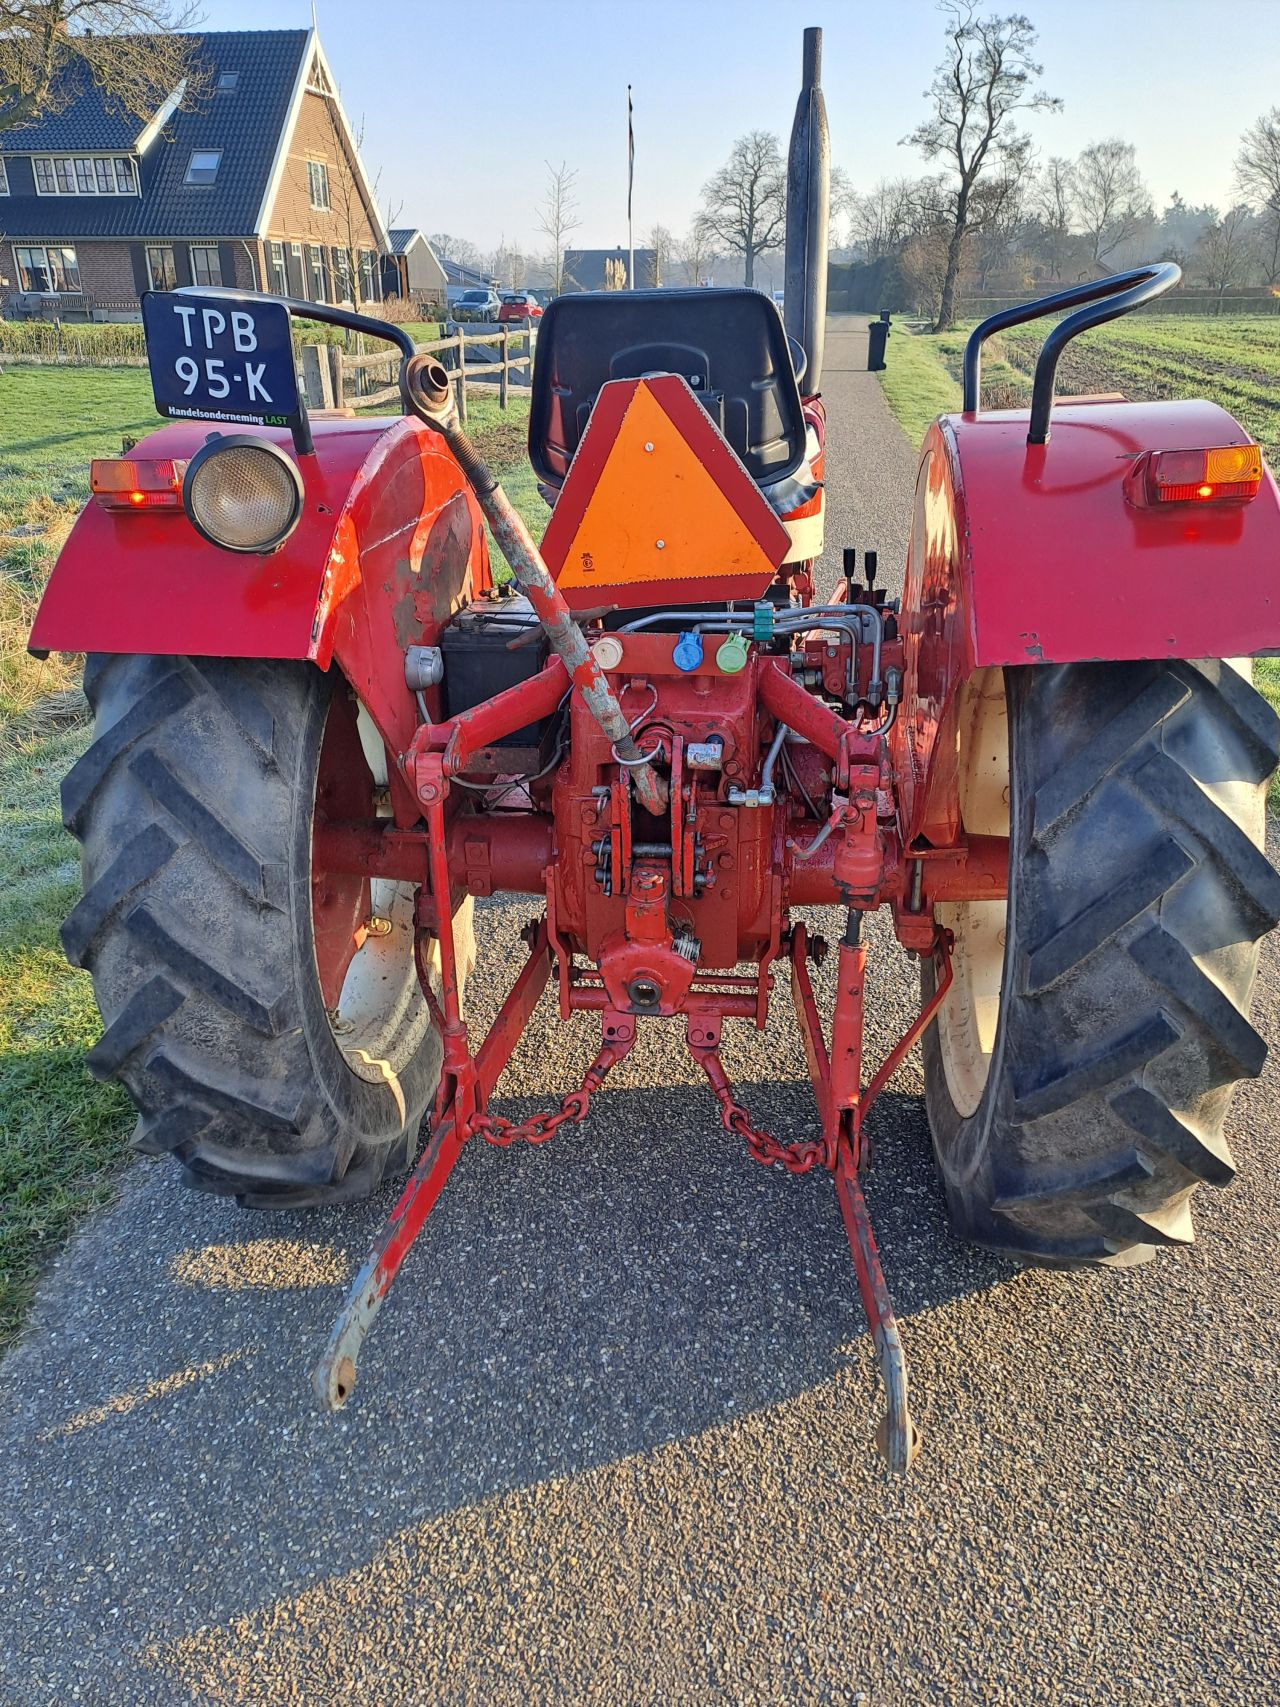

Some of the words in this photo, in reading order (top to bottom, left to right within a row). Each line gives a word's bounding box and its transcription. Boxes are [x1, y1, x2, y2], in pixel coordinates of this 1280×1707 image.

[173, 306, 258, 353] TPB
[175, 356, 273, 403] 95-K
[168, 406, 264, 425] Handelsonderneming
[265, 415, 288, 425] LAST
